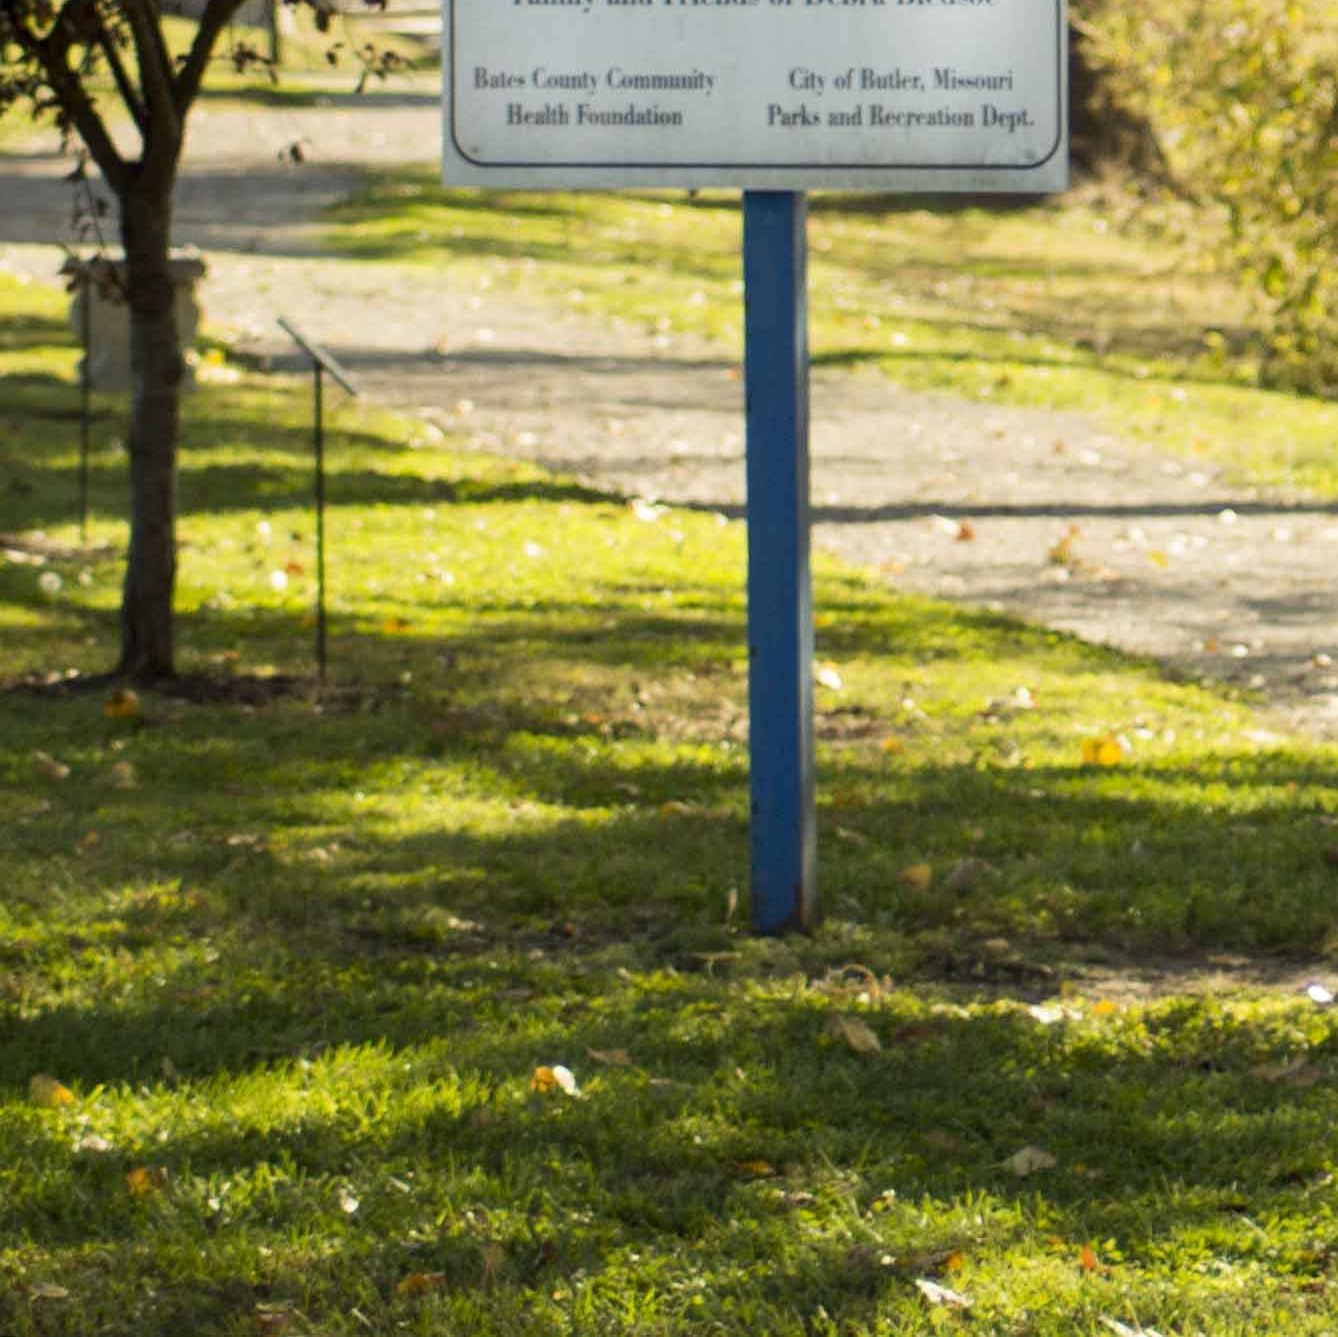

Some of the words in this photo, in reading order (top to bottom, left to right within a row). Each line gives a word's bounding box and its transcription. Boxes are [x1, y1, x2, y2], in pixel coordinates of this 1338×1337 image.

[473, 67, 526, 90] Bates
[531, 67, 599, 95] County
[605, 67, 715, 96] Community
[788, 67, 826, 96] City
[832, 67, 855, 90] of
[859, 67, 925, 91] Butler,
[932, 67, 1013, 91] Missouri
[506, 103, 569, 126] Health
[576, 103, 683, 126] Foundation
[767, 103, 820, 127] Parks
[827, 103, 862, 127] and
[869, 103, 974, 127] Recreation
[981, 103, 1035, 133] Dept.
